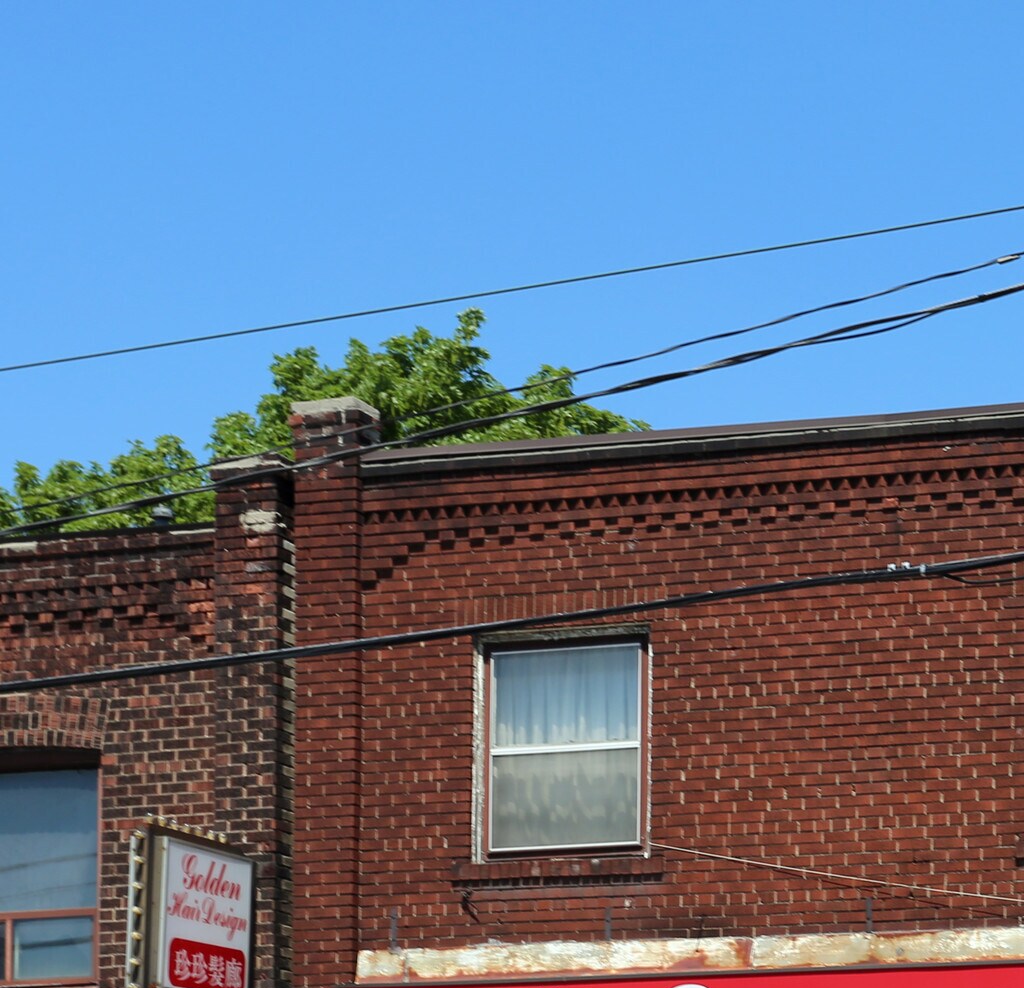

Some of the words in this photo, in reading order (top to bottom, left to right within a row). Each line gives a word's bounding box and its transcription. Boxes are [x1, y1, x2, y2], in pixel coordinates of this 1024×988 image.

[181, 853, 242, 901] Golden
[166, 891, 201, 922] Hair
[201, 896, 247, 942] Design
